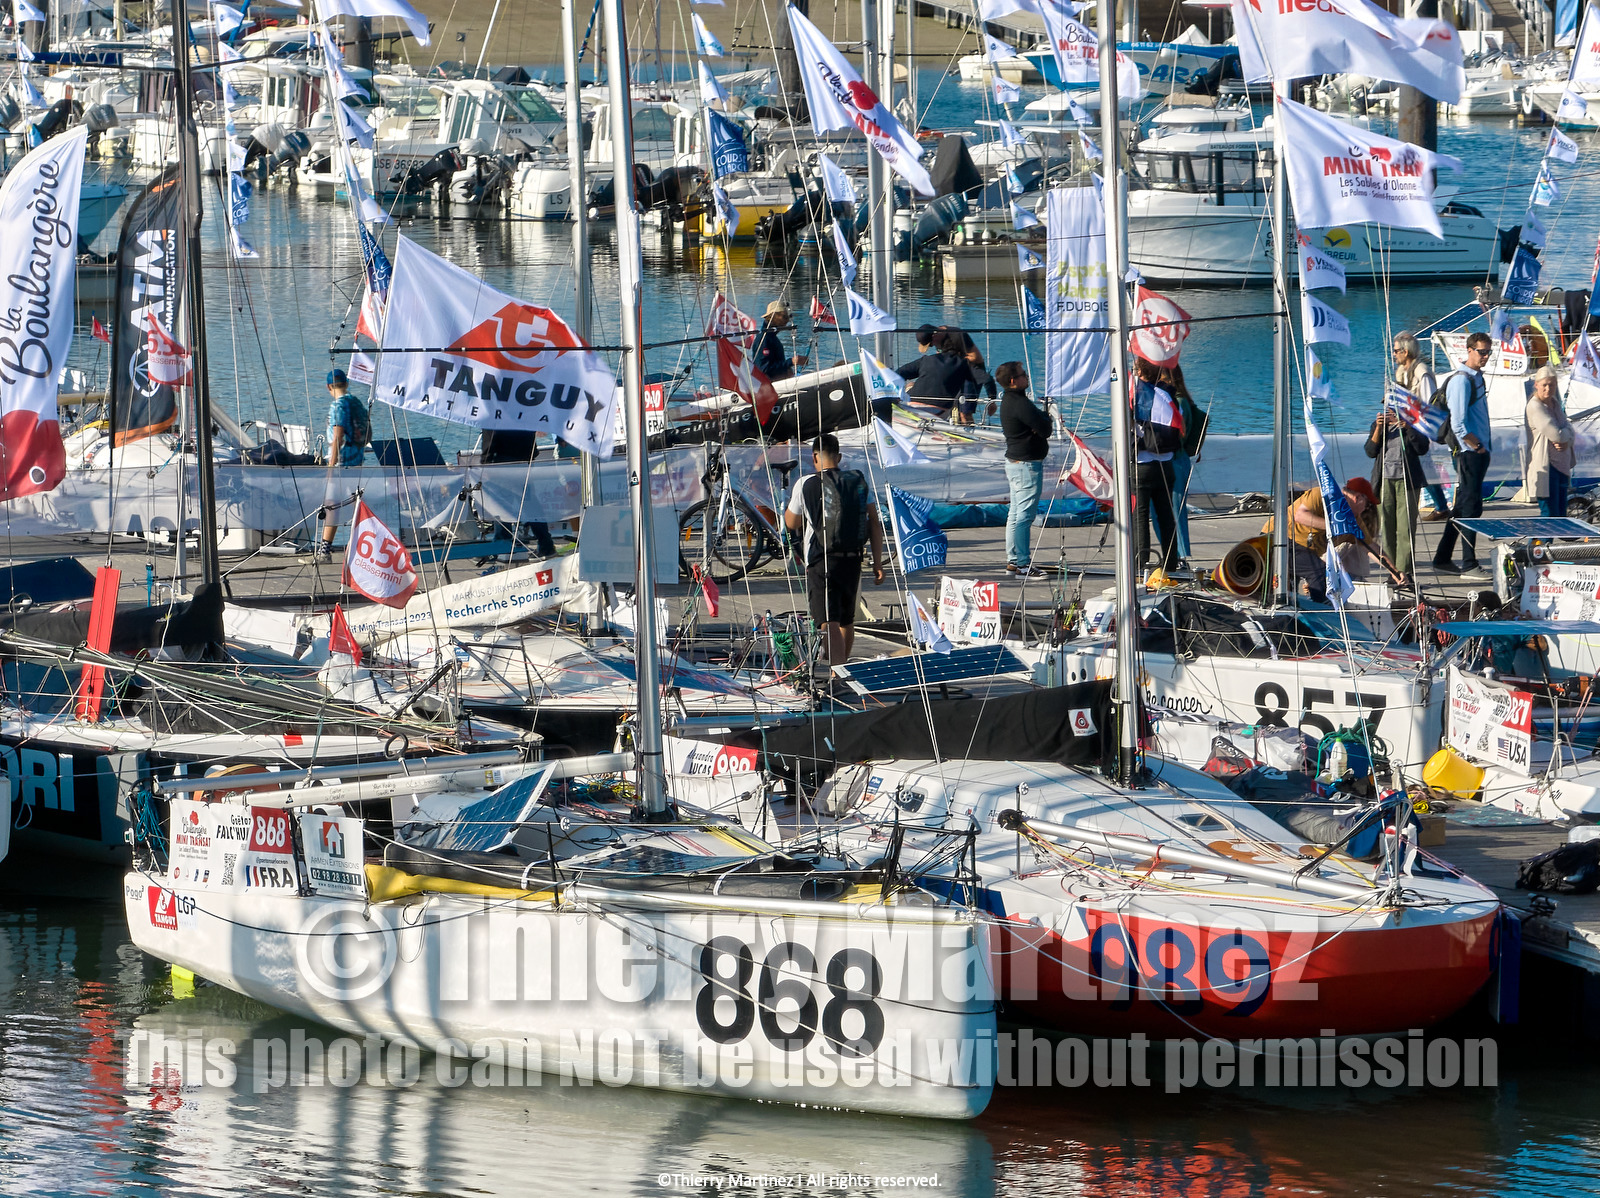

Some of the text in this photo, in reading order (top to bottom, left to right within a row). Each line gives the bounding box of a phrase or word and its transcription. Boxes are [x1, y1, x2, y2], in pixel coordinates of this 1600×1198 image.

[1323, 156, 1373, 177] MINI
[1339, 176, 1354, 188] Les
[0, 158, 73, 386] Boulangère
[130, 228, 176, 333] ATM OMMUNICATION
[430, 357, 606, 423] TANGUY
[392, 384, 598, 443] MATERIAUX
[356, 530, 413, 575] 6.50
[354, 557, 403, 585] classemini
[445, 598, 508, 619] Recherche
[509, 586, 560, 608] Sponsors
[972, 582, 995, 608] 857
[409, 611, 432, 623] 2023
[979, 621, 998, 640] LUX
[1508, 740, 1527, 767] USA
[689, 762, 712, 775] LUCAS
[255, 815, 287, 848] 868
[260, 866, 294, 888] FRA
[312, 869, 360, 885] 02 98 28 33 11
[176, 894, 196, 916] LGP
[154, 913, 176, 926] TANGUY
[1090, 922, 1271, 1018] 989
[695, 935, 886, 1059] 868
